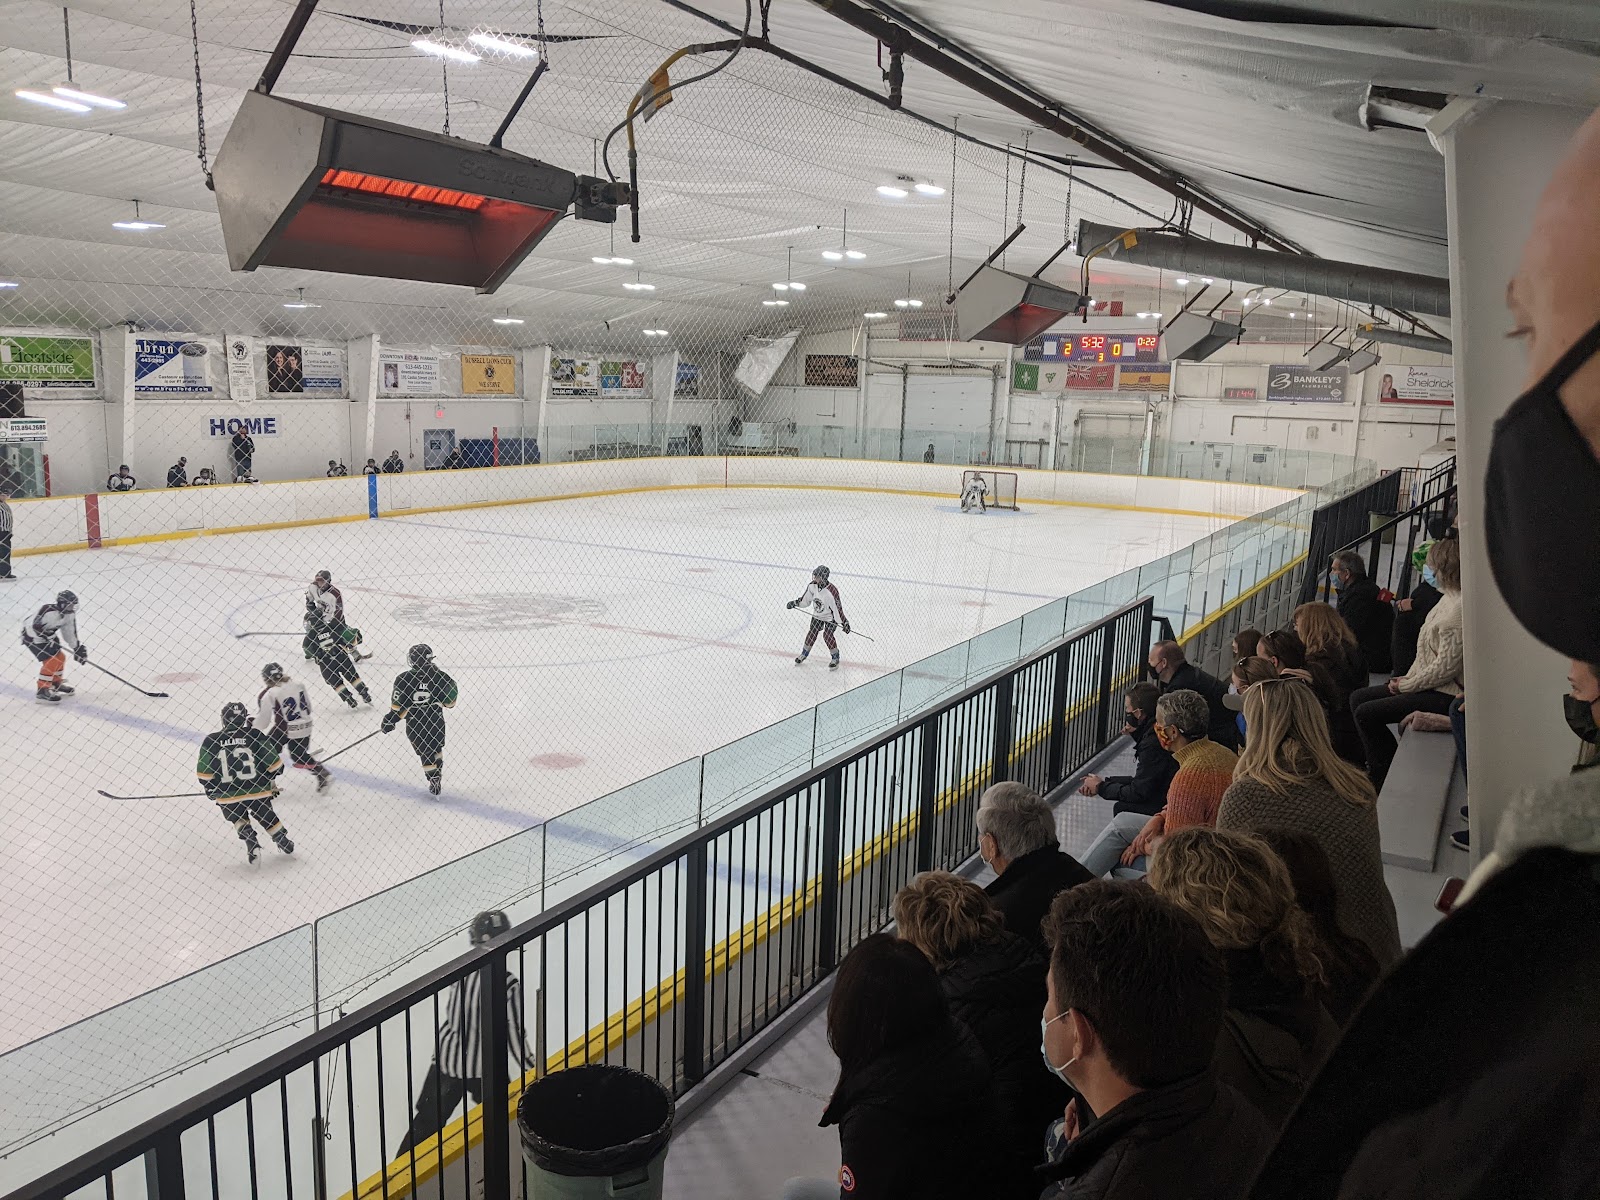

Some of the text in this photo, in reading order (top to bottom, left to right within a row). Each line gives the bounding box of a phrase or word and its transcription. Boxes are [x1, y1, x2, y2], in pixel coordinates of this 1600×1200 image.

[1082, 336, 1105, 348] 5:32
[1137, 337, 1156, 346] 0:22
[1064, 343, 1072, 355] 2
[1113, 343, 1121, 356] 0
[1098, 352, 1104, 362] 3
[2, 364, 75, 374] CONTRACTING
[1293, 375, 1342, 384] BANKLEY'S
[1406, 377, 1454, 388] Sheldrick
[209, 417, 277, 436] HOME
[392, 690, 401, 701] 6
[217, 747, 257, 784] 13
